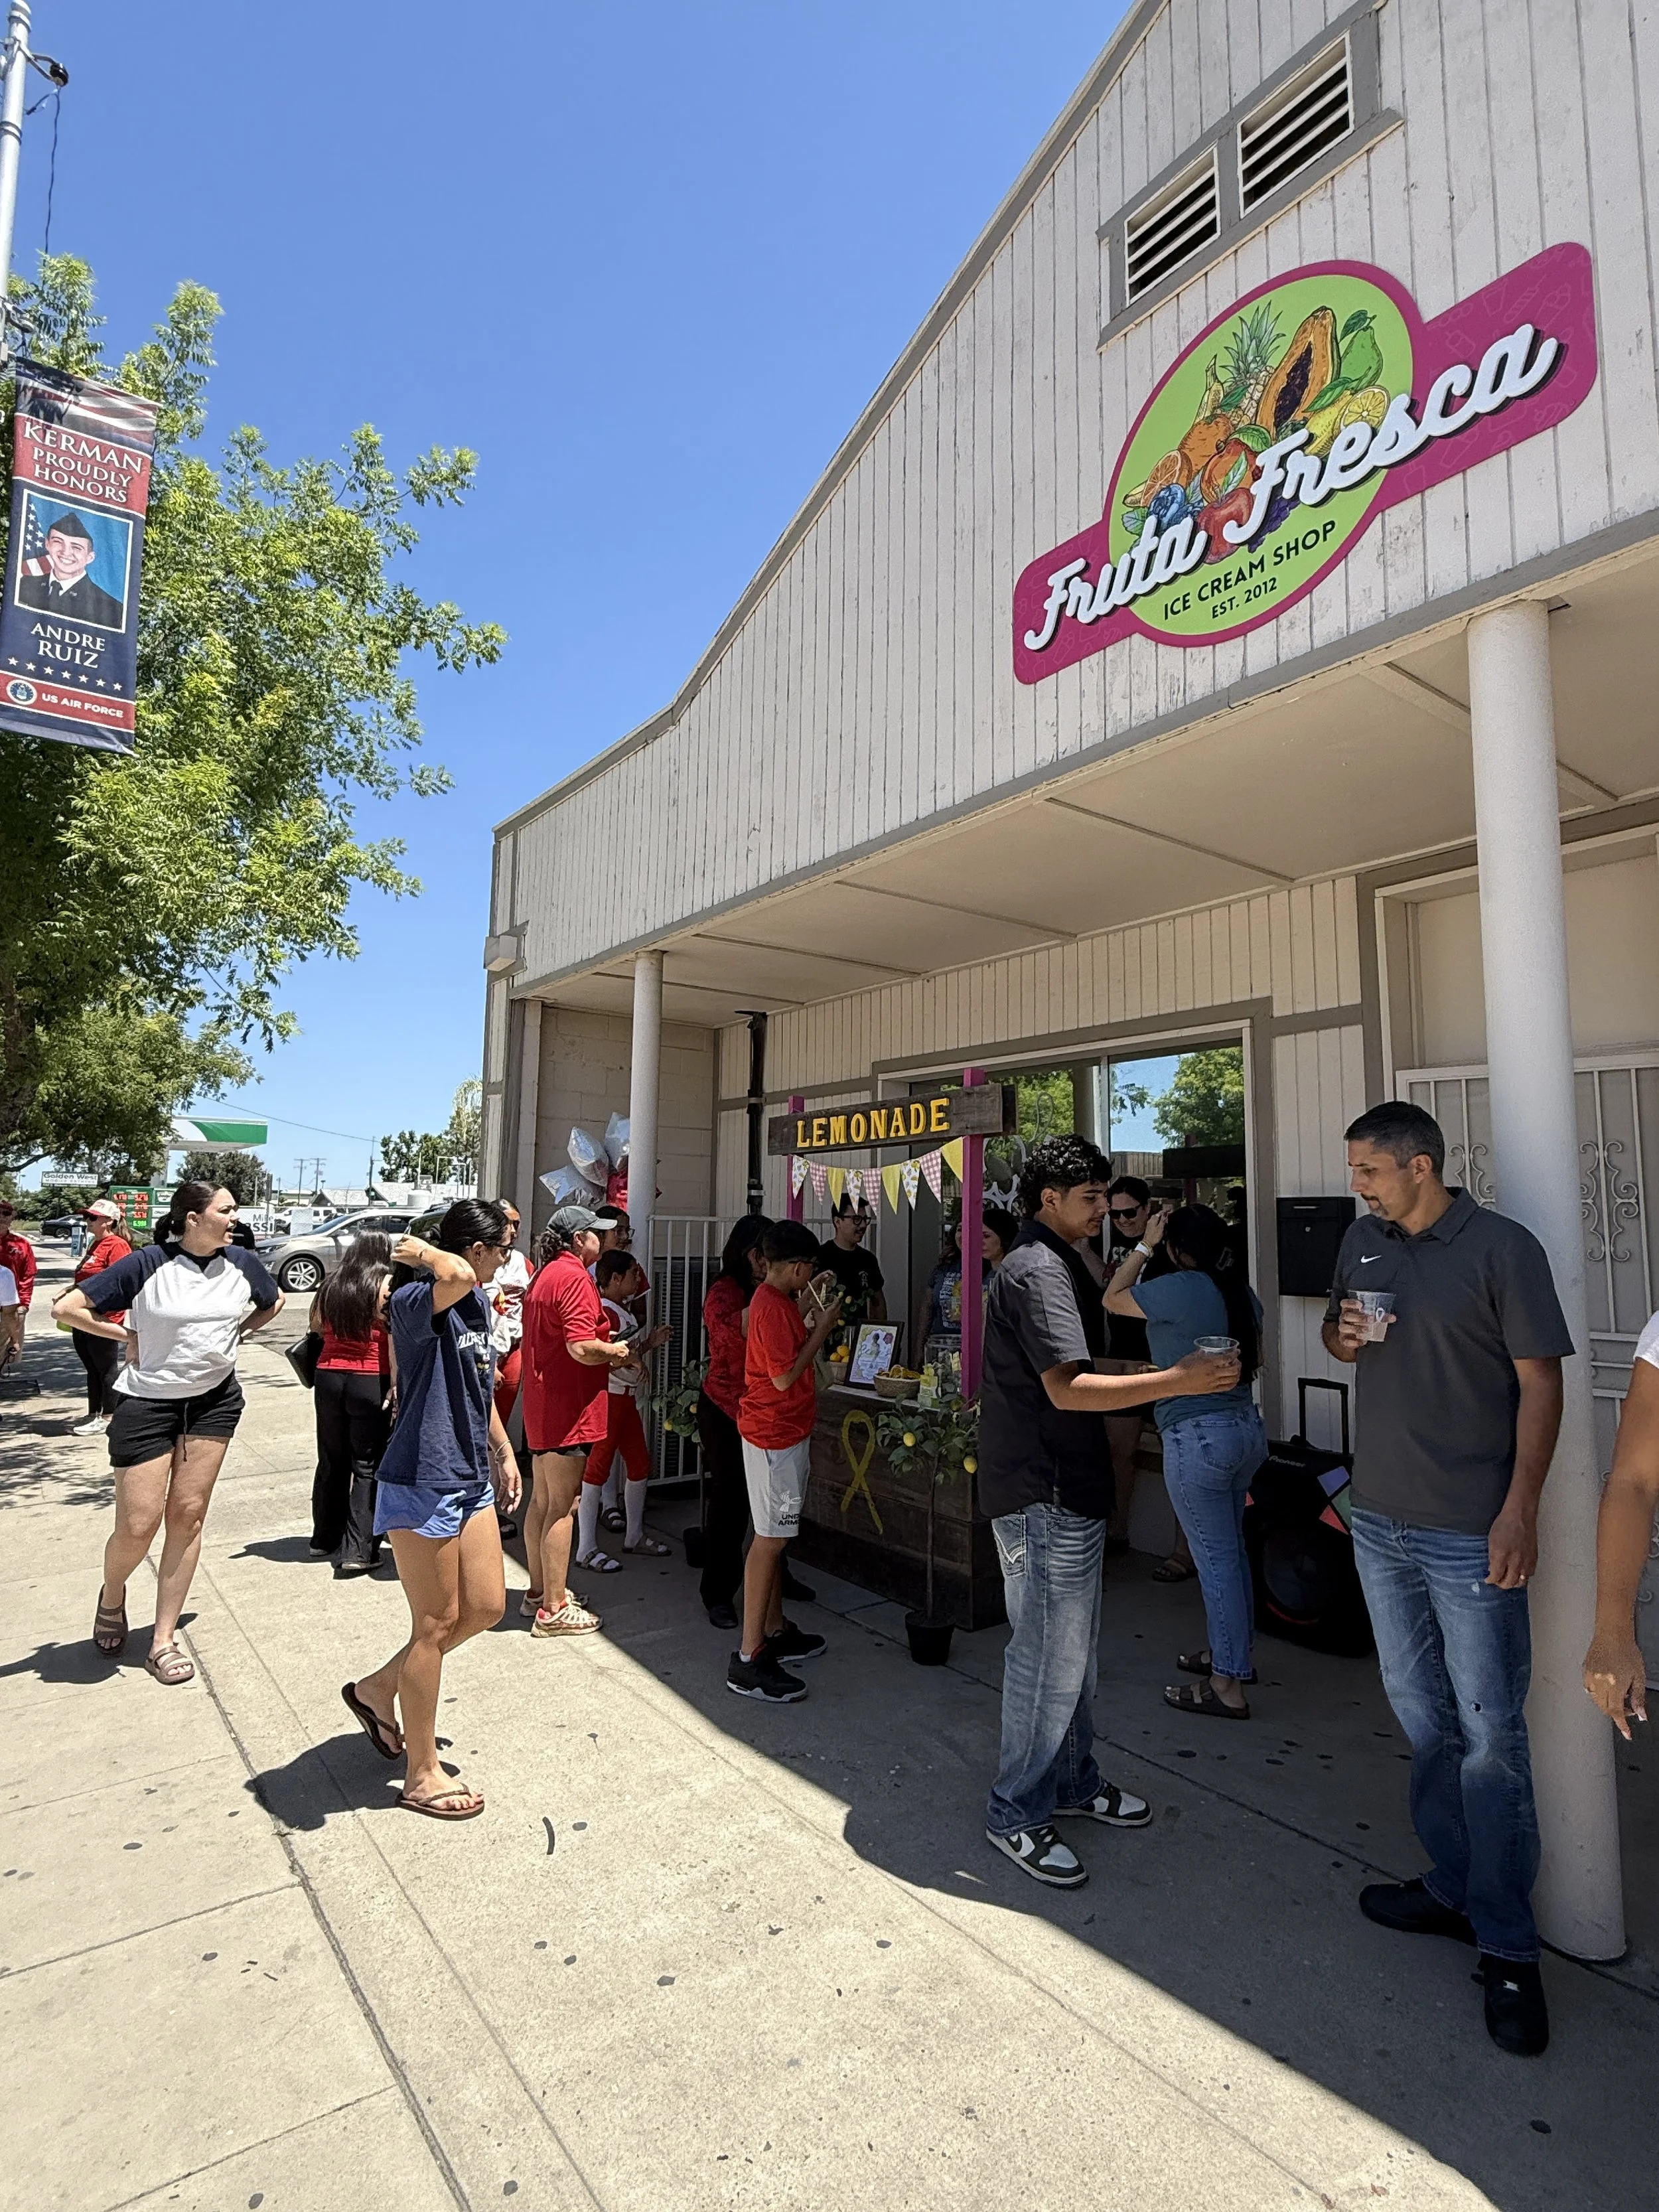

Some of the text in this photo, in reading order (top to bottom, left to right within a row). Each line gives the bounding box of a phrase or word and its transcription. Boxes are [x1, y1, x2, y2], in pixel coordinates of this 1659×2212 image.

[24, 421, 143, 474] KERMAN
[33, 447, 133, 488] PROUDLY
[34, 463, 127, 502] HONORS
[1024, 324, 1558, 651] Fruta Fresca
[1164, 520, 1336, 621] ICE CREAM SHOP
[1212, 577, 1277, 619] EST. 2012
[31, 623, 106, 651] ANDRE
[38, 640, 98, 668] RUIZ
[42, 692, 124, 718] US AIR FORCE
[796, 1098, 950, 1147] LEMONADE
[1268, 1455, 1306, 1467] Pioneer
